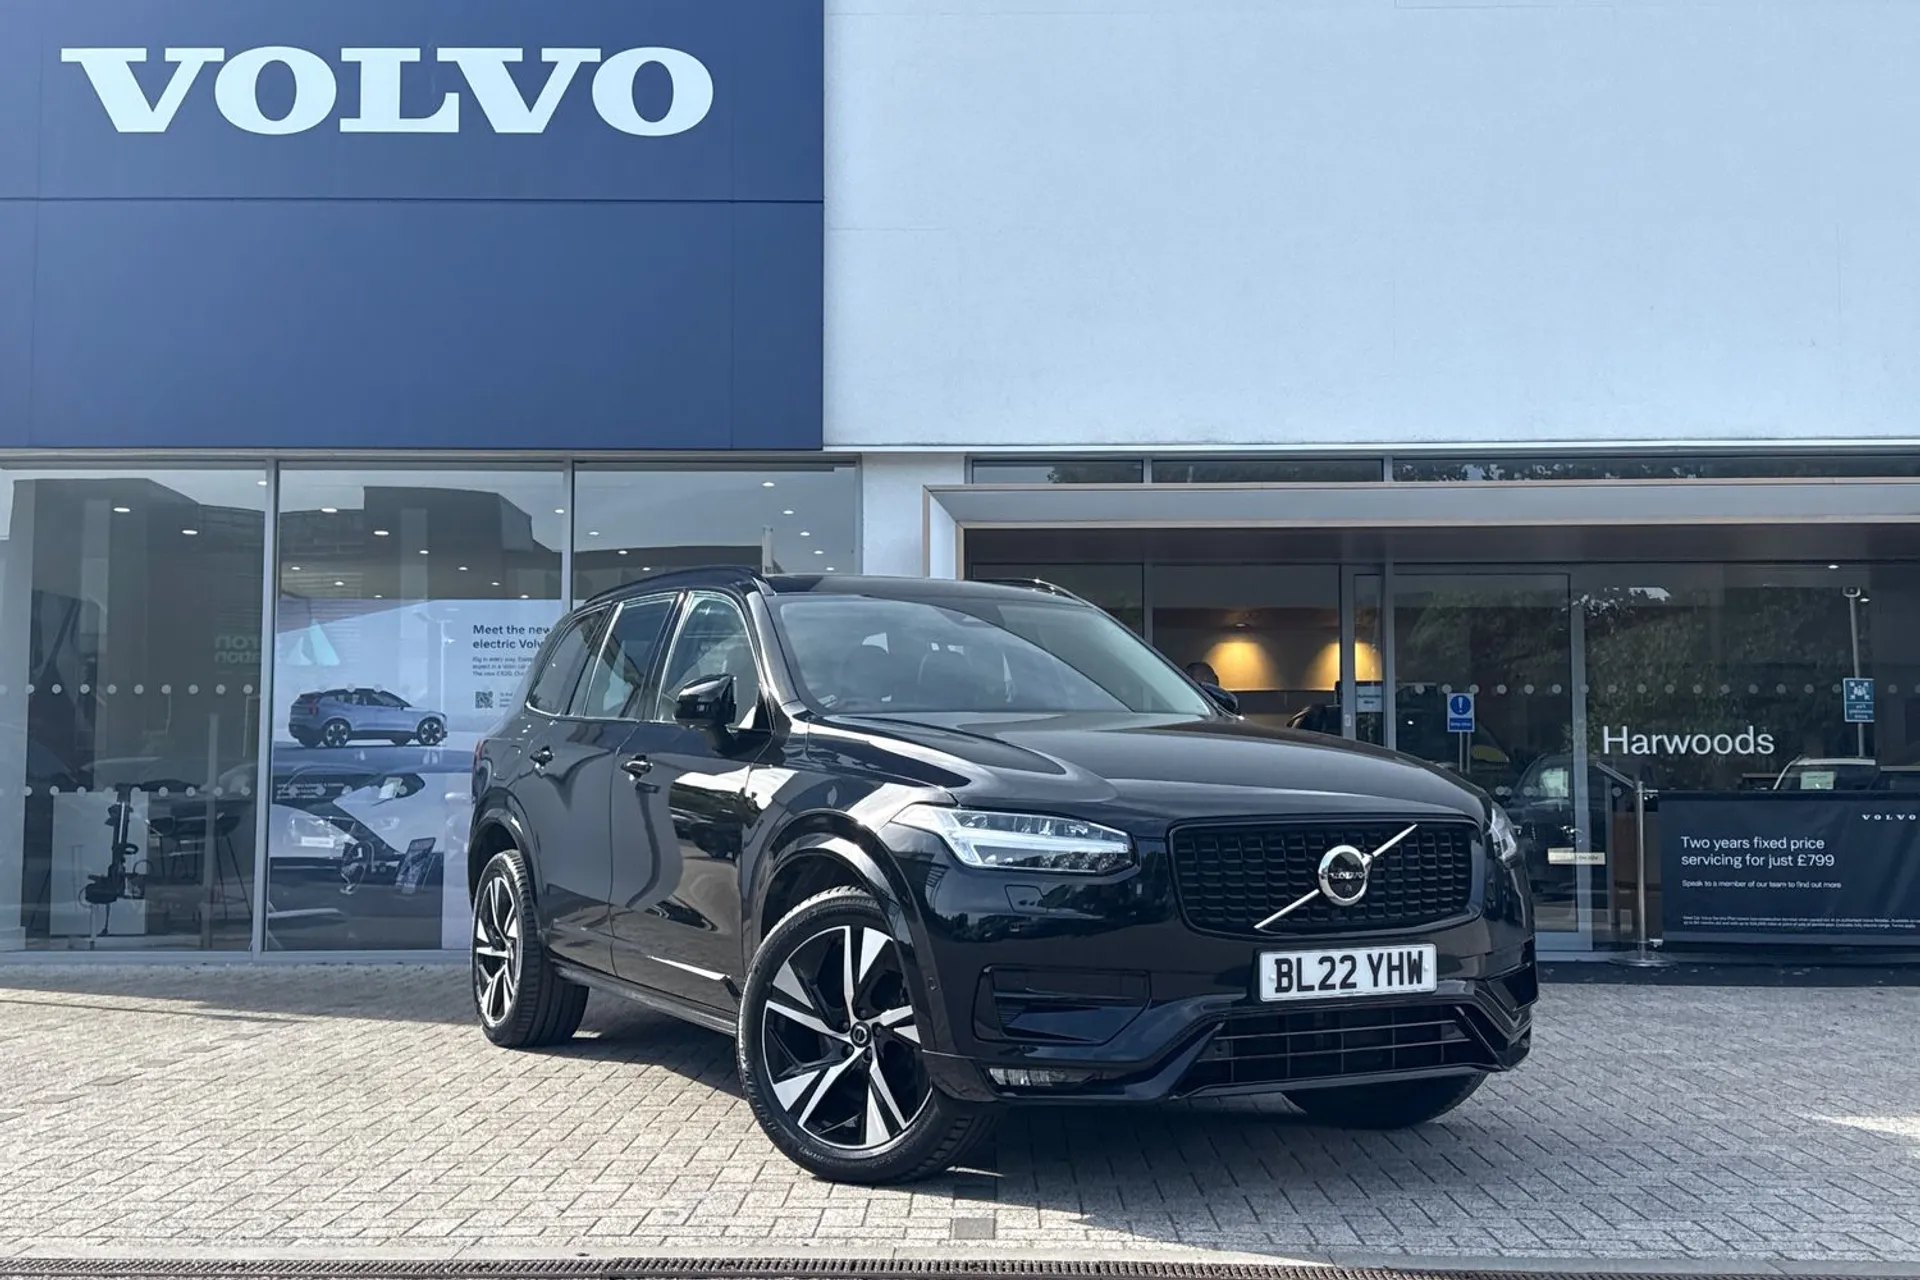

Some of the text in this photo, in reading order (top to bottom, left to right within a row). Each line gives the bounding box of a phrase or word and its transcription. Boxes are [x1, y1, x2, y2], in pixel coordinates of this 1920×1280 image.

[61, 46, 713, 136] VOLVO
[473, 624, 503, 635] Meet
[506, 624, 525, 635] the
[472, 639, 543, 649] electric Volv
[1602, 725, 1775, 756] Harwoods
[1861, 813, 1917, 821] VOLVO
[1681, 836, 1825, 851] Two years fixed price
[1681, 853, 1835, 868] servicing for just £799
[1682, 879, 1703, 888] Speak
[1718, 880, 1746, 888] member
[1274, 950, 1424, 993] BL22 YHW
